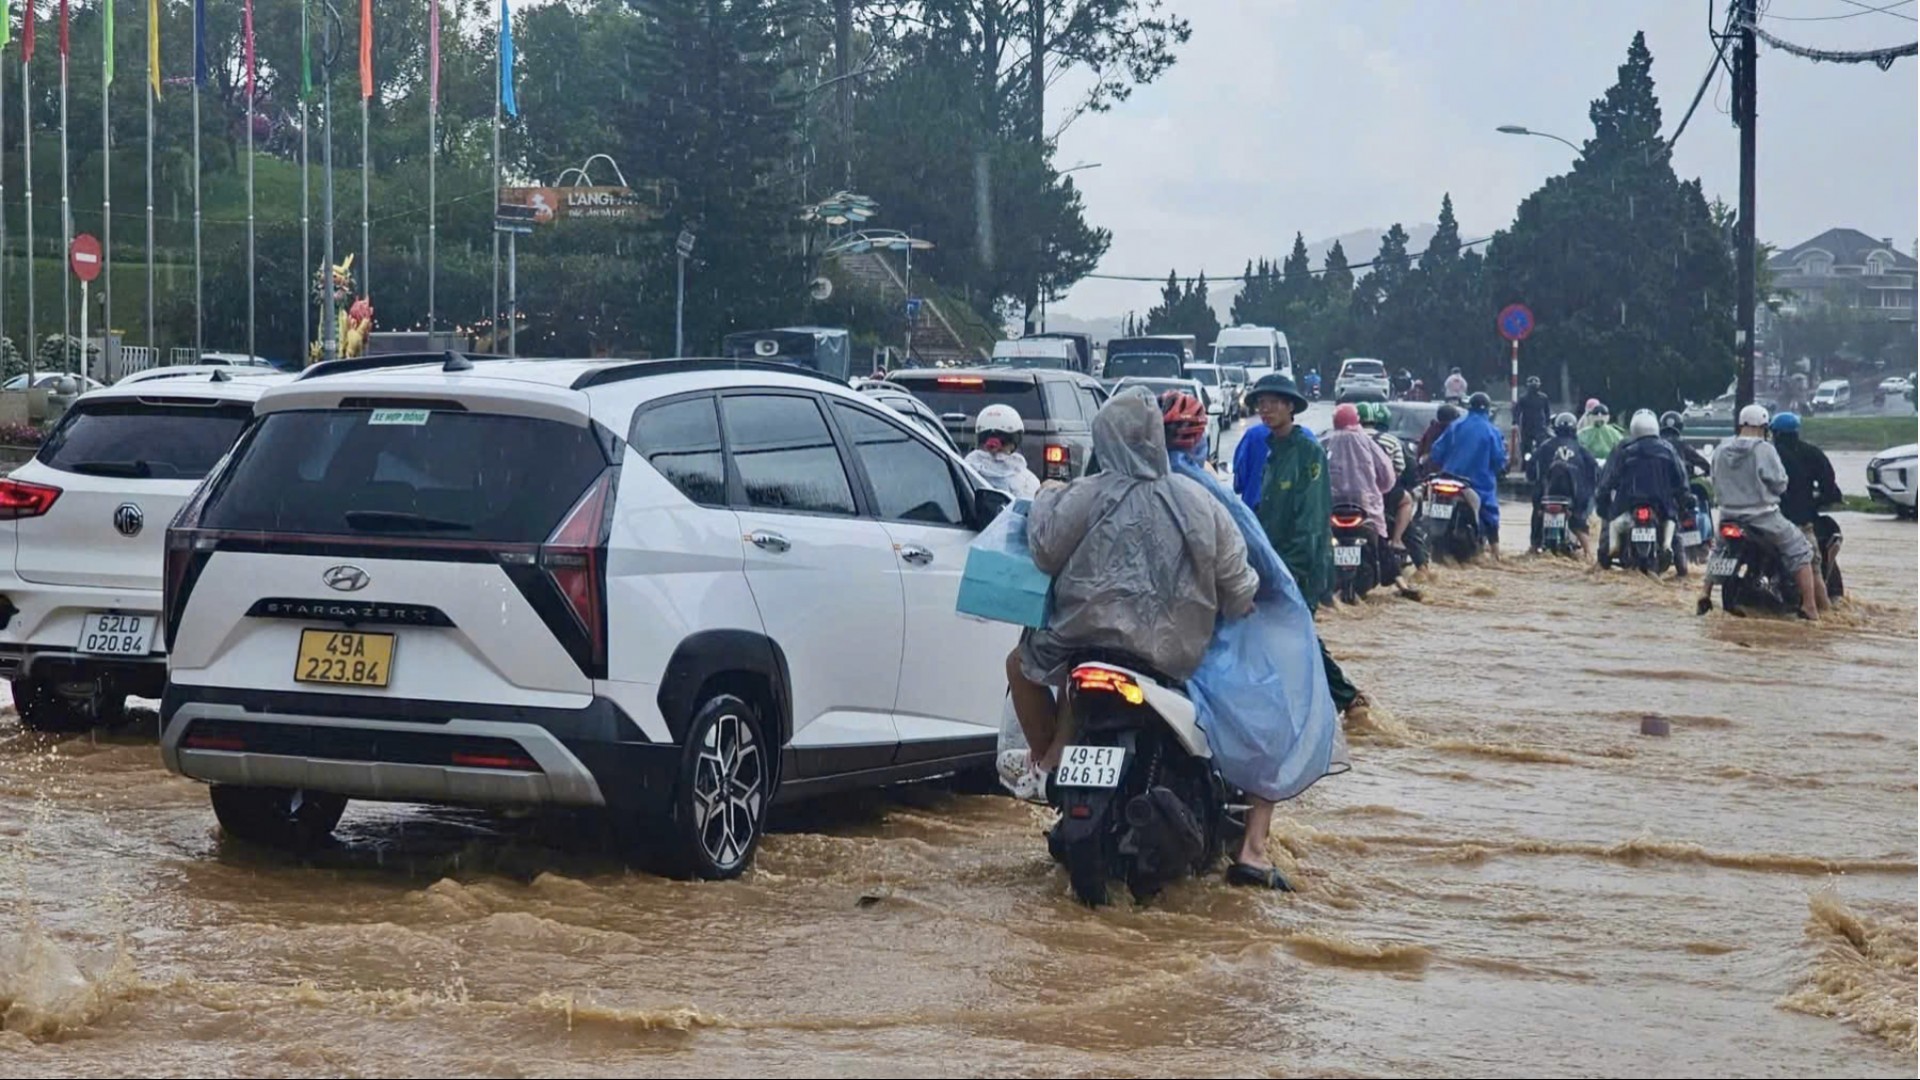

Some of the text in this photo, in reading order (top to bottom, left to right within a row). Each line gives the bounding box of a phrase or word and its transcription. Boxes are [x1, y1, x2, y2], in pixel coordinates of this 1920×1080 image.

[268, 603, 405, 618] STARGAZER
[99, 616, 140, 633] 62LD
[87, 634, 142, 652] 020.84
[326, 634, 364, 656] 49A
[305, 658, 378, 682] 223.84
[1070, 748, 1112, 765] 49-E1
[1060, 766, 1115, 784] 846.13
